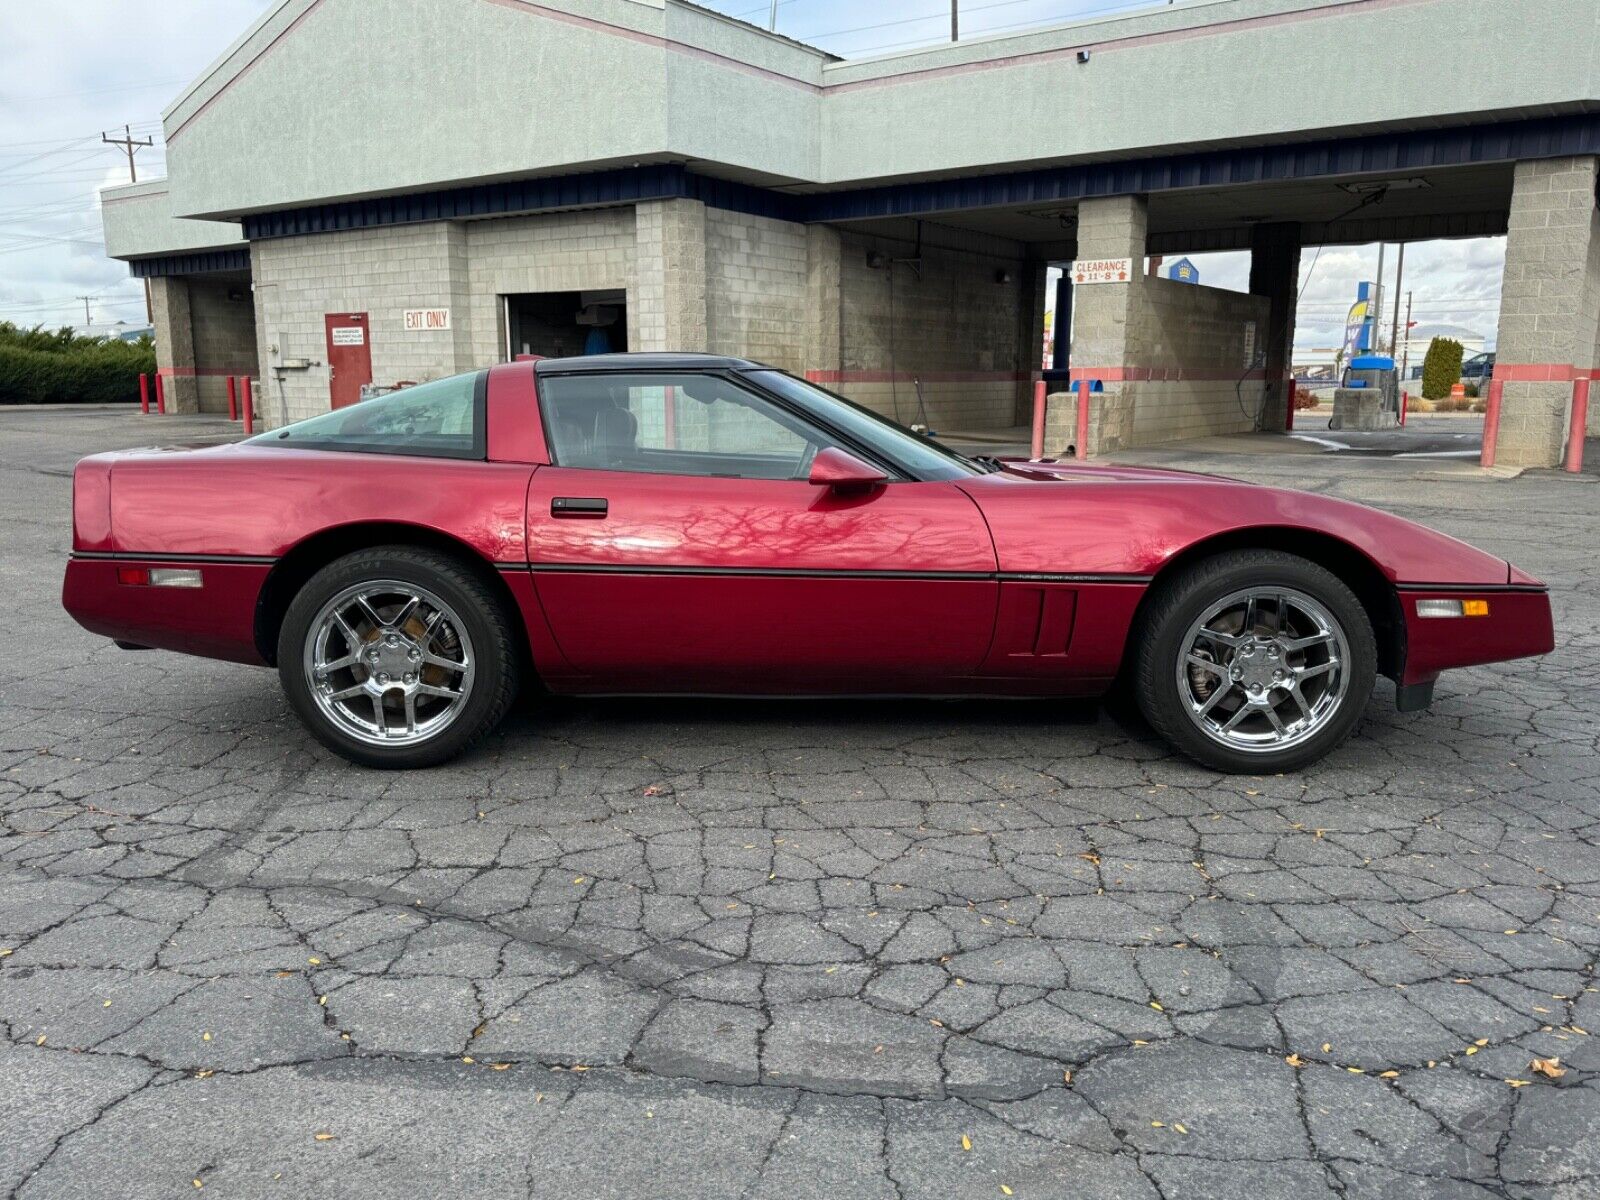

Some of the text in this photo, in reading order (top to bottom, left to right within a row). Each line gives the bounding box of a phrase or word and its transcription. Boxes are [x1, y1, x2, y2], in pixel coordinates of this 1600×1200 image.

[1076, 261, 1127, 272] CLEARANCE
[406, 311, 447, 328] EXIT ONLY
